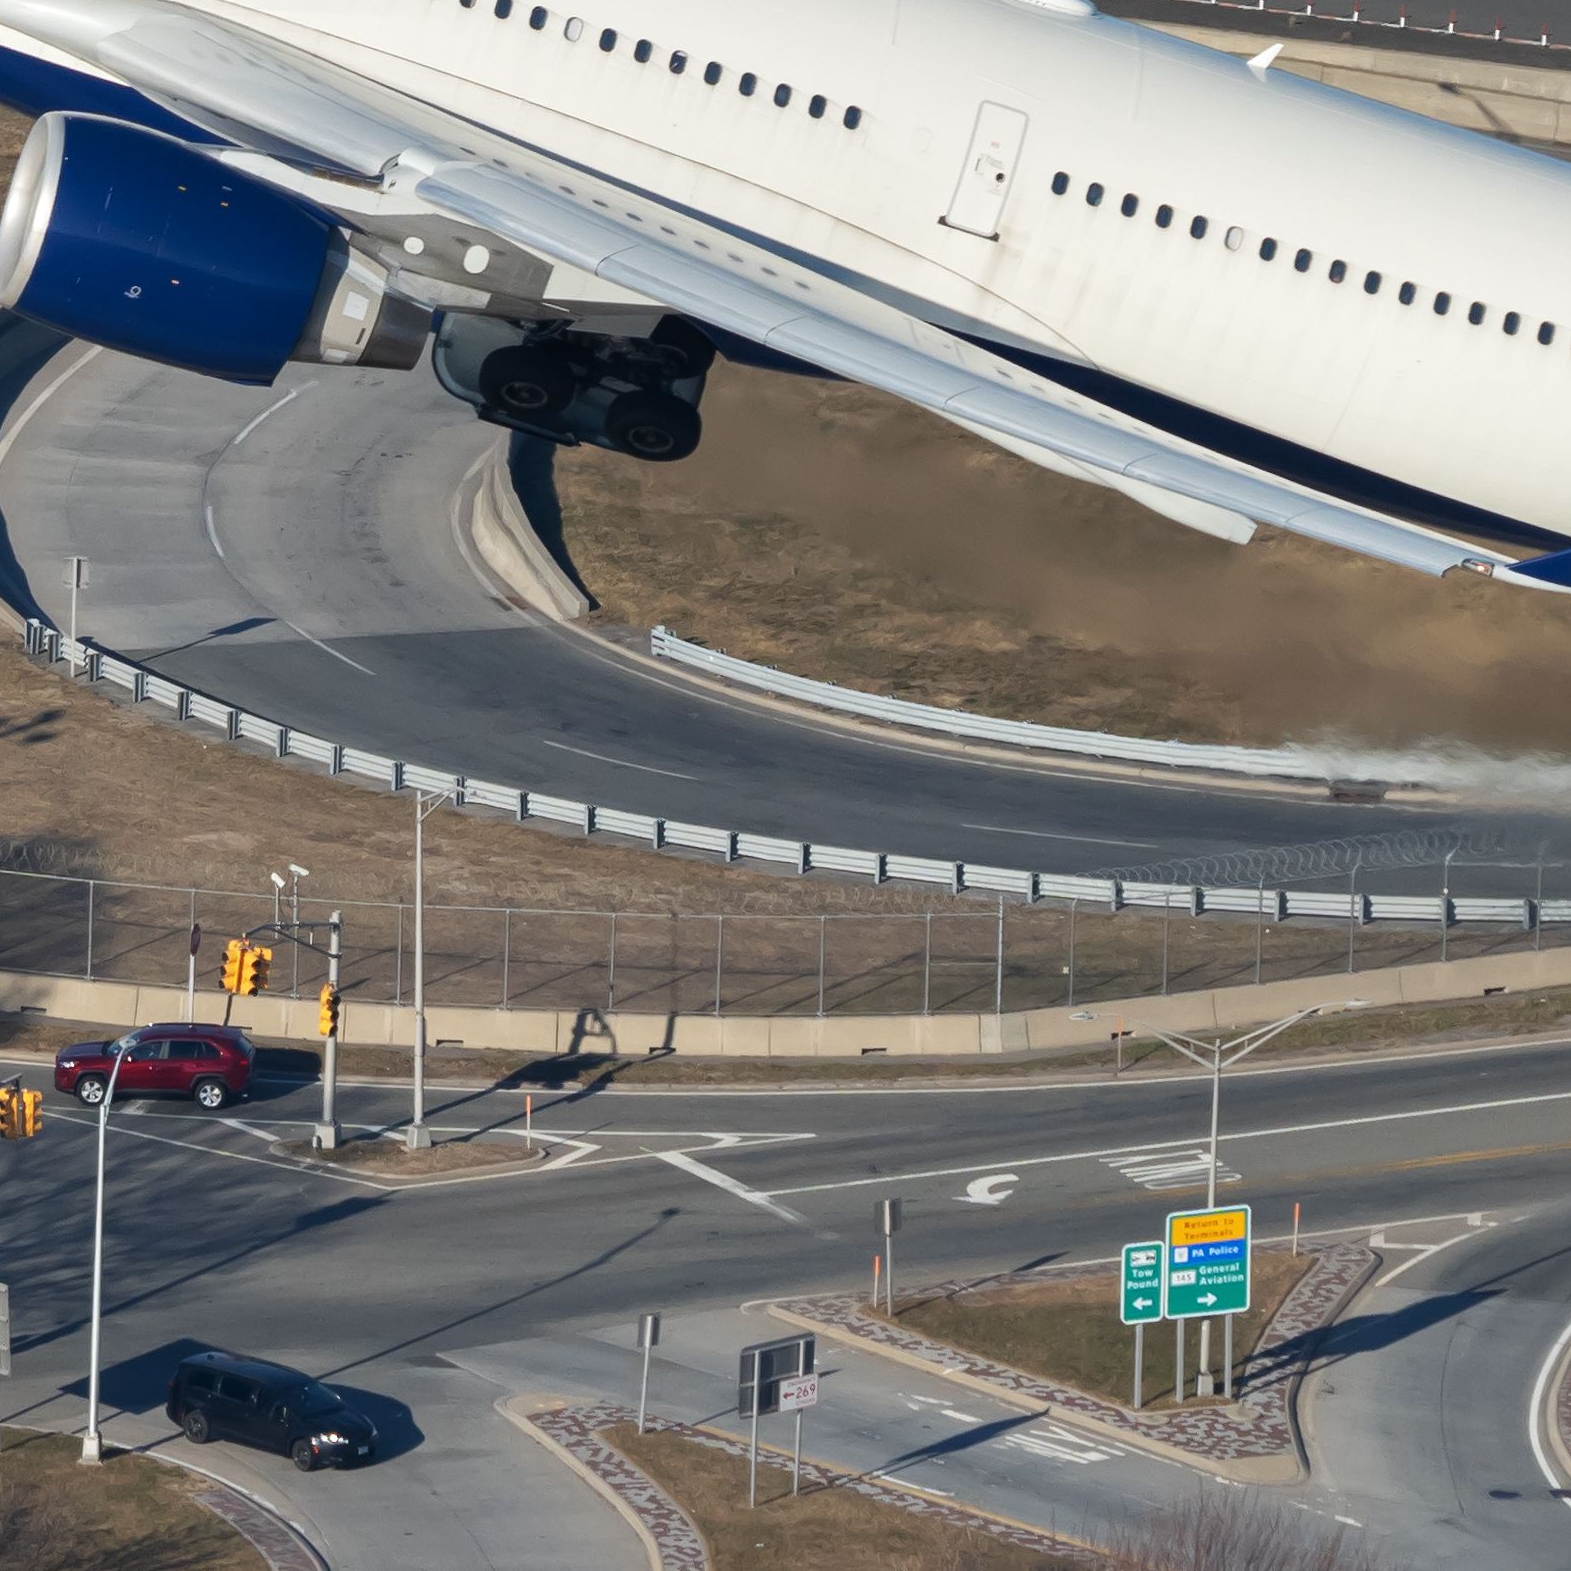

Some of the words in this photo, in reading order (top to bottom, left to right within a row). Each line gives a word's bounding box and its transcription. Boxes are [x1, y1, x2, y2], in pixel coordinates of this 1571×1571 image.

[1184, 1219, 1219, 1229] Return
[1184, 1229, 1234, 1240] Terminals
[1192, 1248, 1205, 1257] PA
[1209, 1245, 1239, 1256] Police
[1132, 1269, 1154, 1278] Tow
[1199, 1262, 1240, 1275] General
[1127, 1278, 1159, 1289] Pound
[1199, 1274, 1244, 1285] Aviation
[796, 1383, 816, 1399] 269
